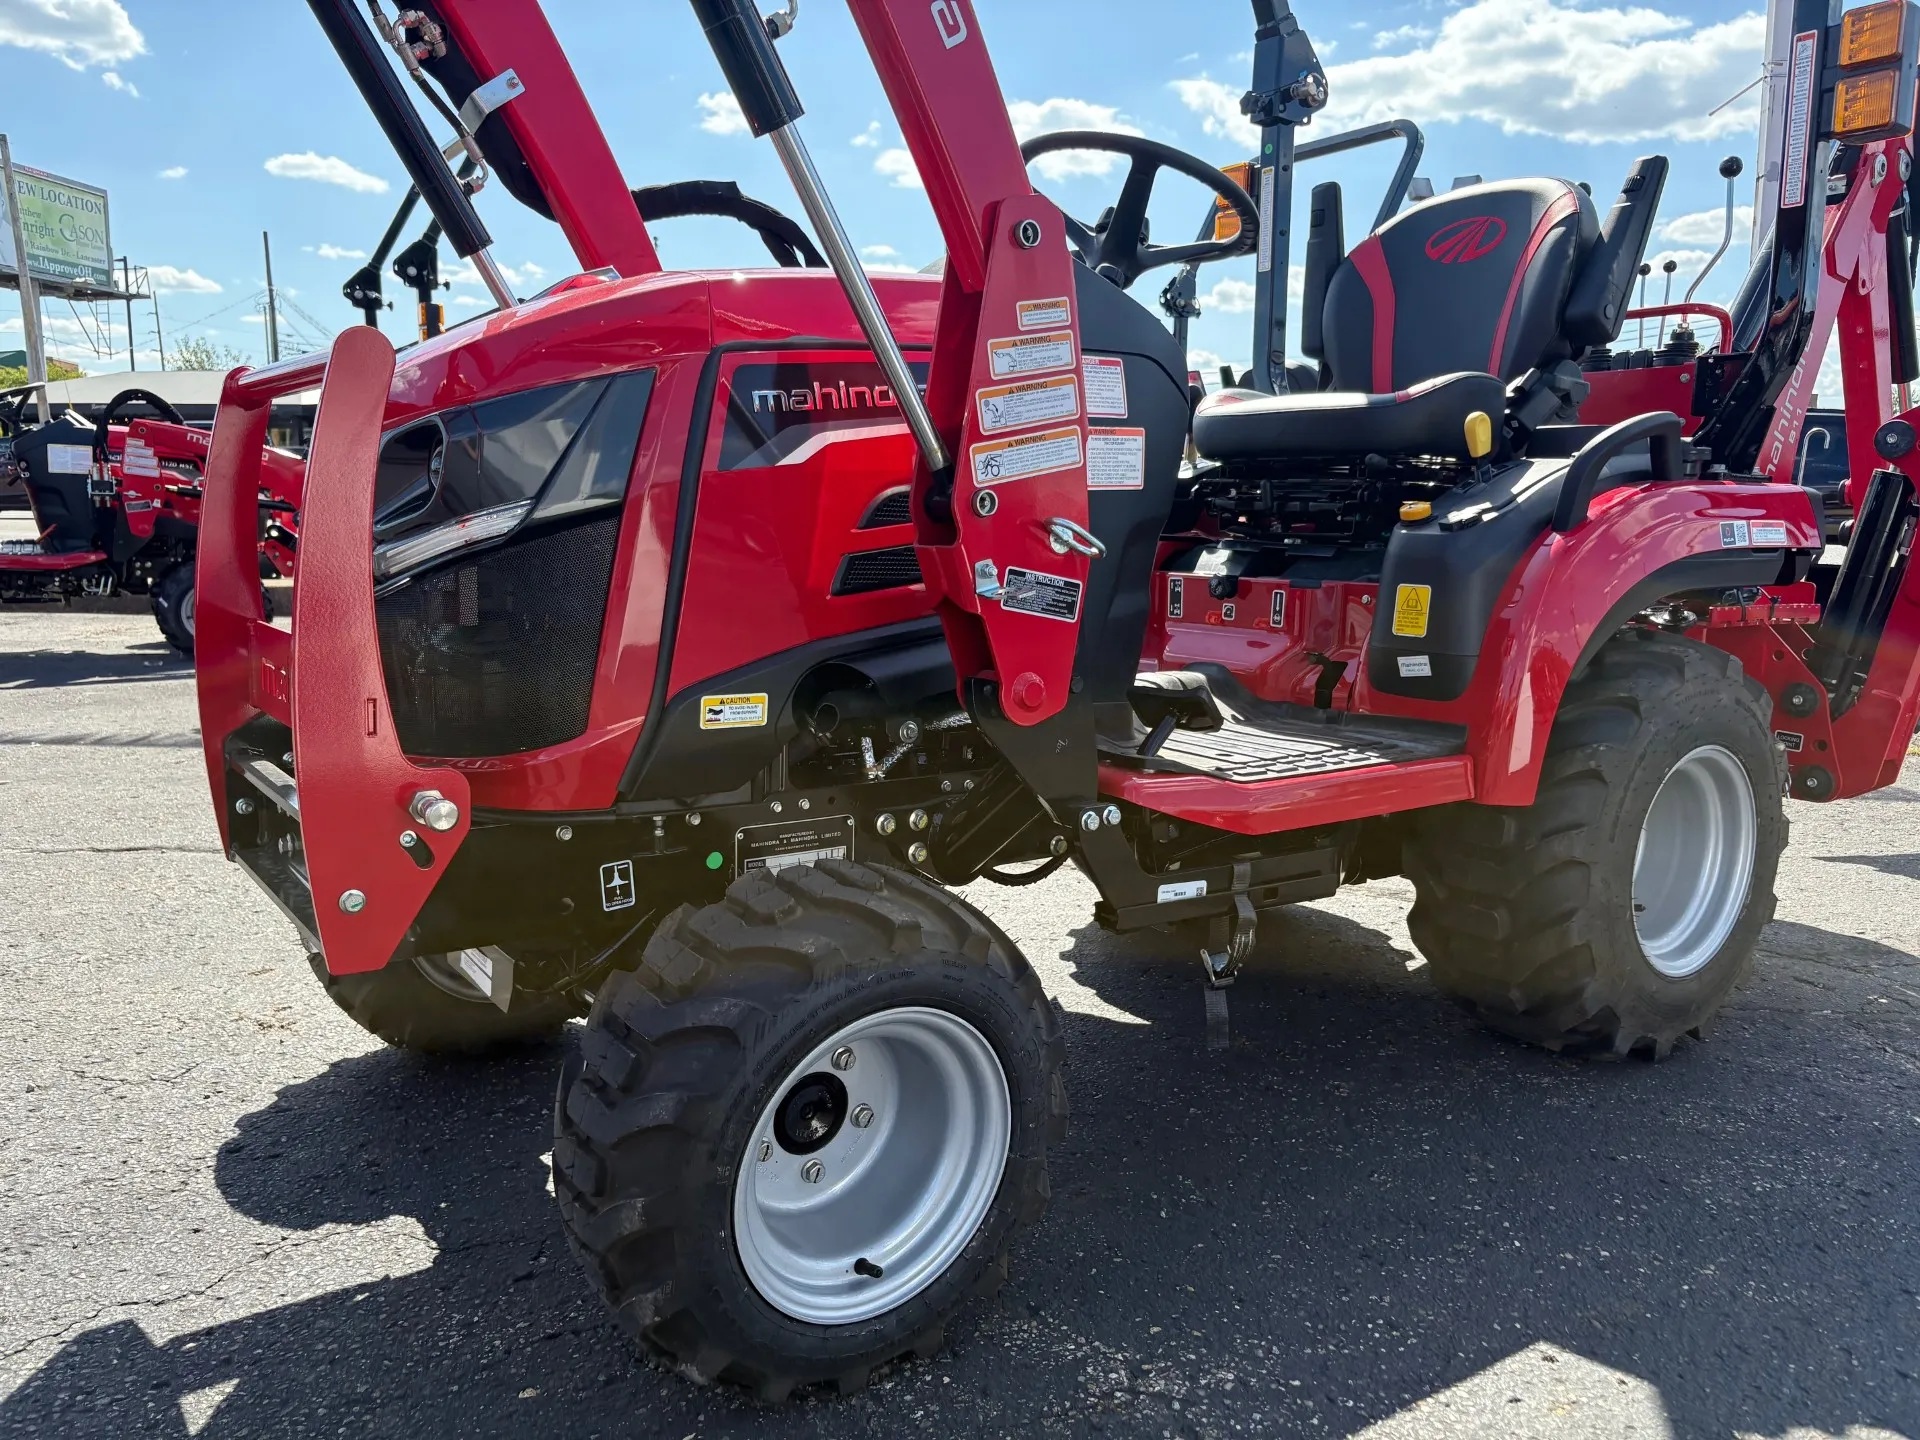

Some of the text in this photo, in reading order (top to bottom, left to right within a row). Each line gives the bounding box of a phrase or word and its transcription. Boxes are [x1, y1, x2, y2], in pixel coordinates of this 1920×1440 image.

[15, 180, 103, 215] EW LOCATION
[23, 220, 55, 239] nright
[59, 213, 104, 245] CASON
[30, 241, 59, 255] Rainbow
[27, 256, 107, 281] ww.IApproveOH.com
[1032, 302, 1061, 311] WARNING
[1019, 336, 1052, 346] WARNING
[1016, 382, 1048, 394] WARNING
[1092, 428, 1117, 436] WARNING
[1014, 434, 1047, 447] WARNING
[1025, 572, 1065, 587] INSTRUCTION
[725, 697, 751, 705] CAUTION
[1777, 735, 1800, 743] LOCKING
[751, 840, 780, 848] MAHINDRA
[790, 834, 819, 843] MAHINDRA
[821, 831, 842, 839] LIMITED
